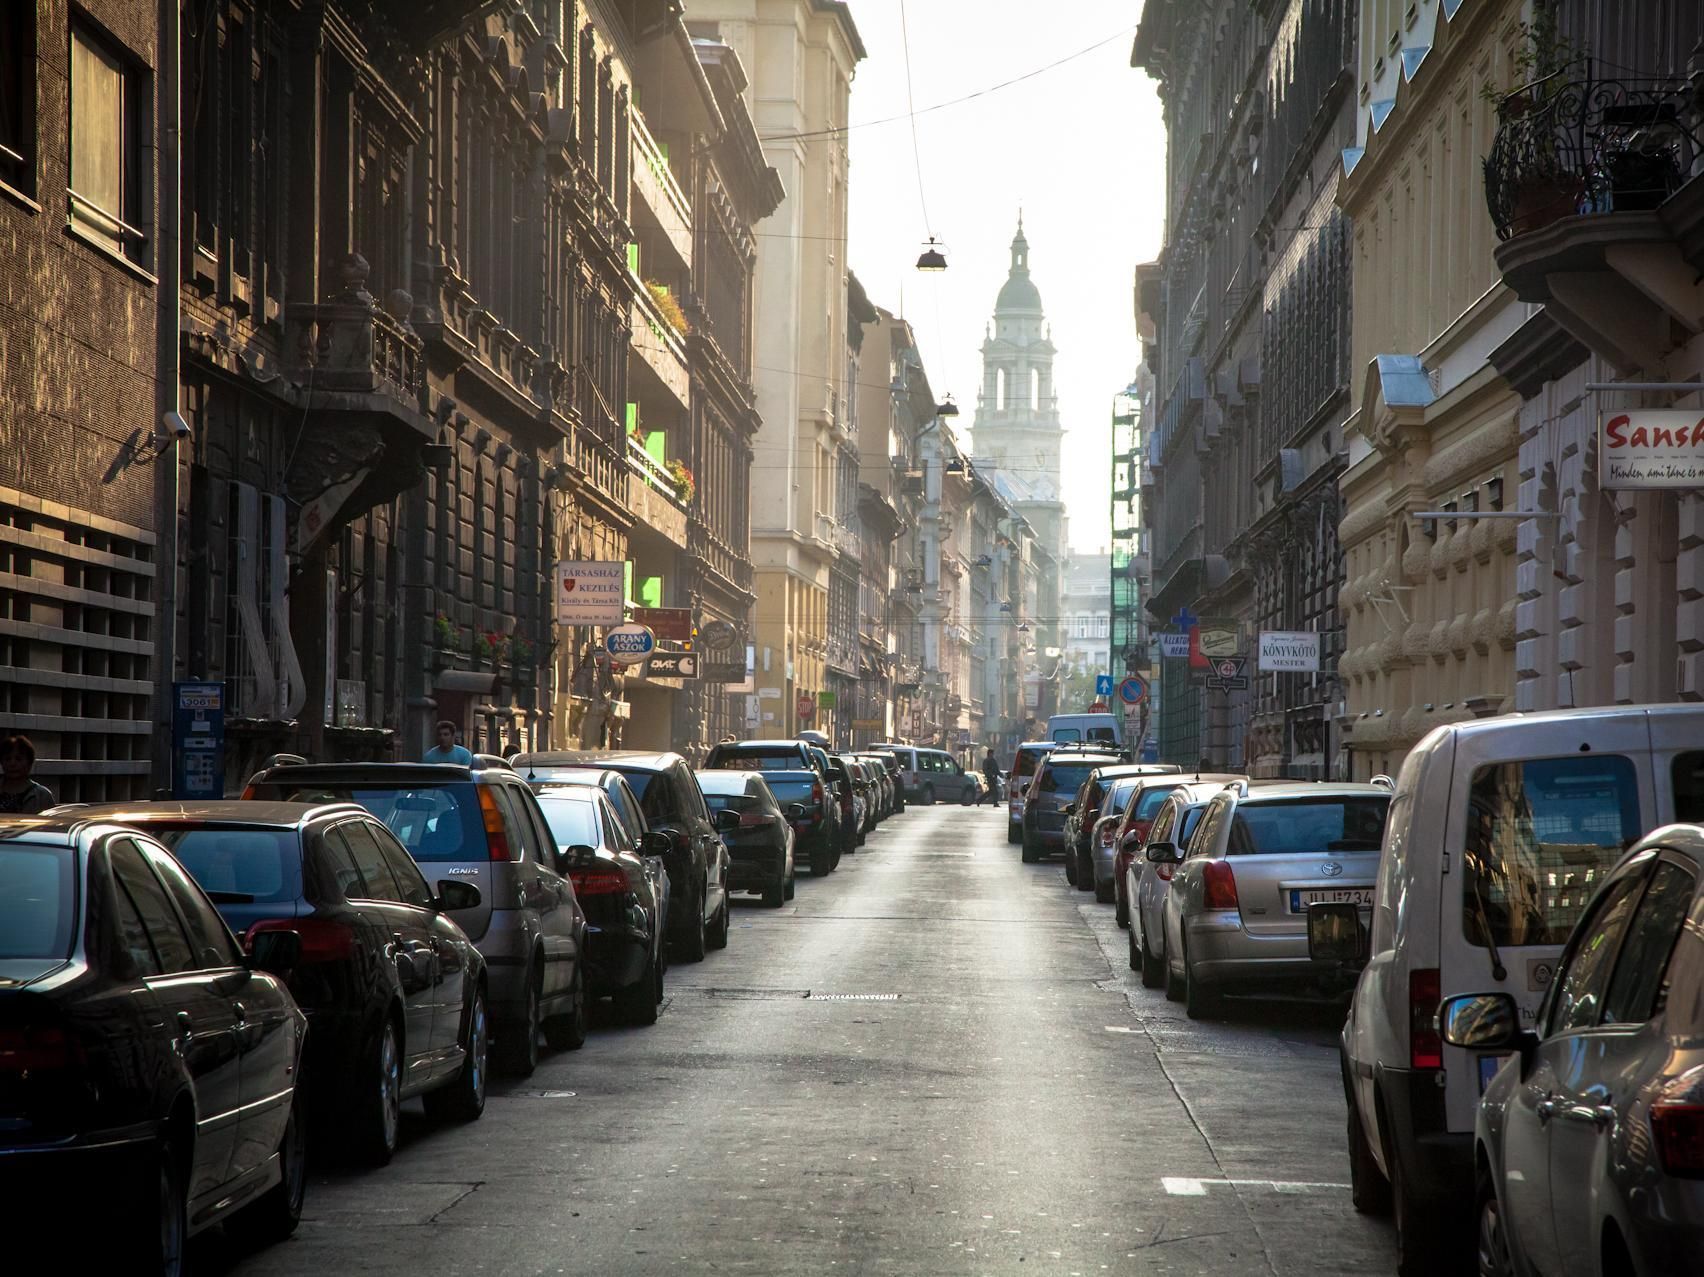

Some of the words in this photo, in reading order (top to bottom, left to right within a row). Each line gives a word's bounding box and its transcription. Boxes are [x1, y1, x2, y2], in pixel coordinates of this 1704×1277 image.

[1647, 465, 1665, 478] ami
[563, 568, 620, 577] TÁRSASHÁZ
[579, 583, 620, 592] KEZELÉS
[613, 634, 647, 645] ARANY
[448, 867, 480, 875] IGNIS
